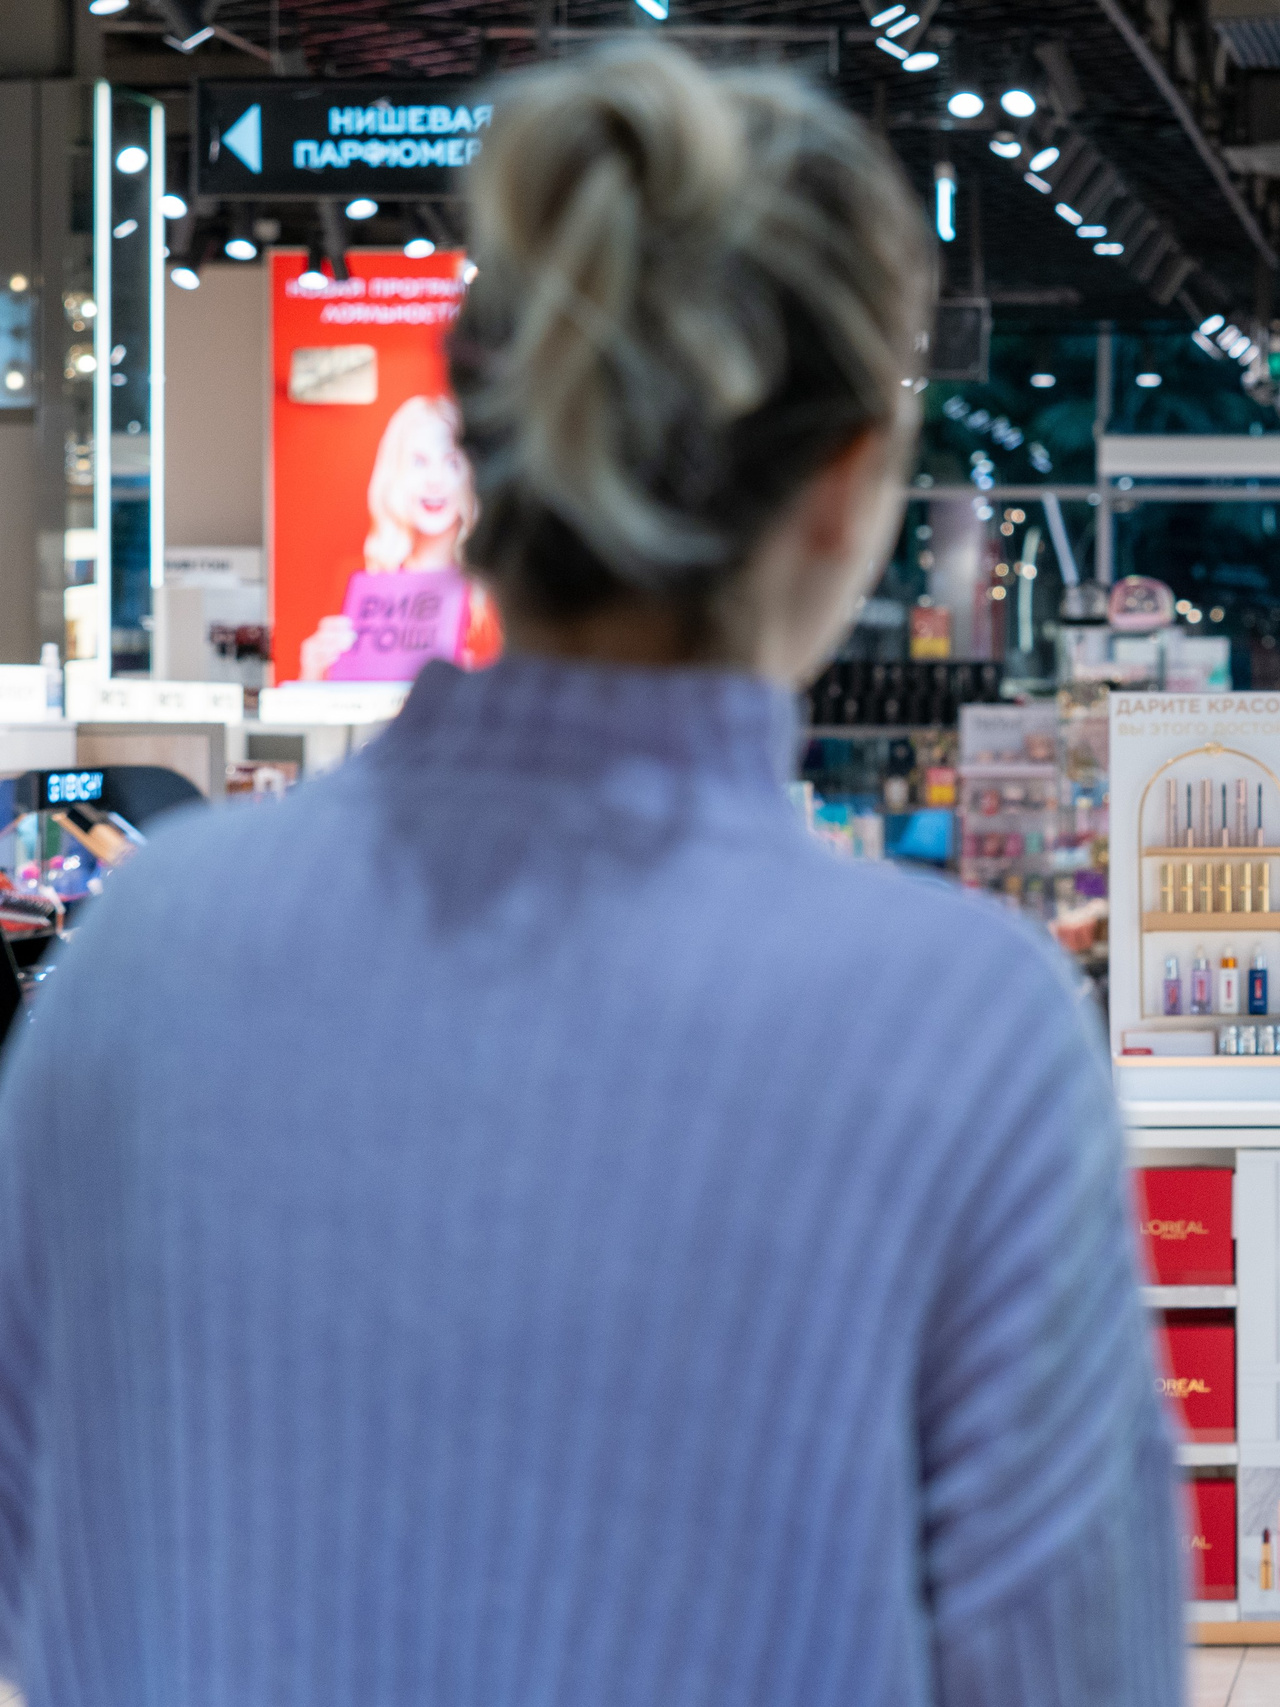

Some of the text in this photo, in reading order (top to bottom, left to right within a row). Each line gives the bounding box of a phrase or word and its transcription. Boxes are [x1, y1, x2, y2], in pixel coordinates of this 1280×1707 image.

[328, 105, 493, 135] НИШЕВАЯ
[1117, 698, 1200, 716] ДАРИТЕ
[1151, 722, 1208, 737] ЭТОГО
